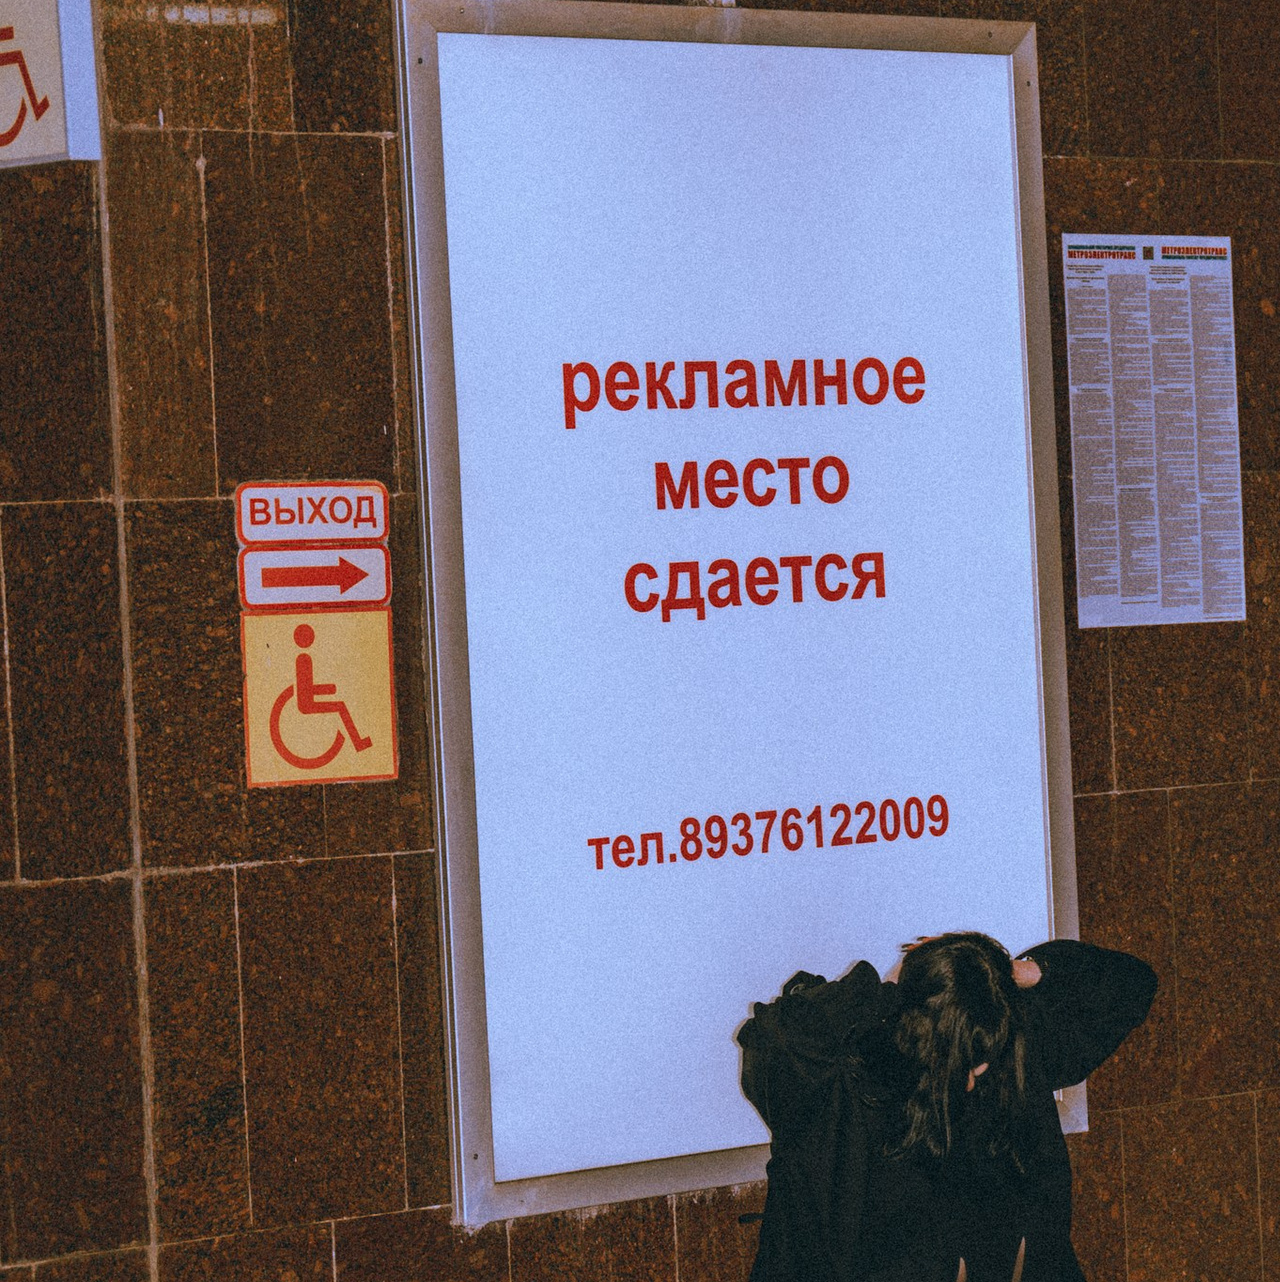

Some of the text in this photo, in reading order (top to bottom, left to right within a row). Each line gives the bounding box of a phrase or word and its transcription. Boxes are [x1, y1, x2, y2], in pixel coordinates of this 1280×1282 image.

[561, 355, 927, 430] рекламное
[248, 495, 379, 530] ВЫХОД
[654, 455, 850, 510] место
[623, 551, 887, 623] сдается
[586, 794, 950, 870] тел.89376122009
